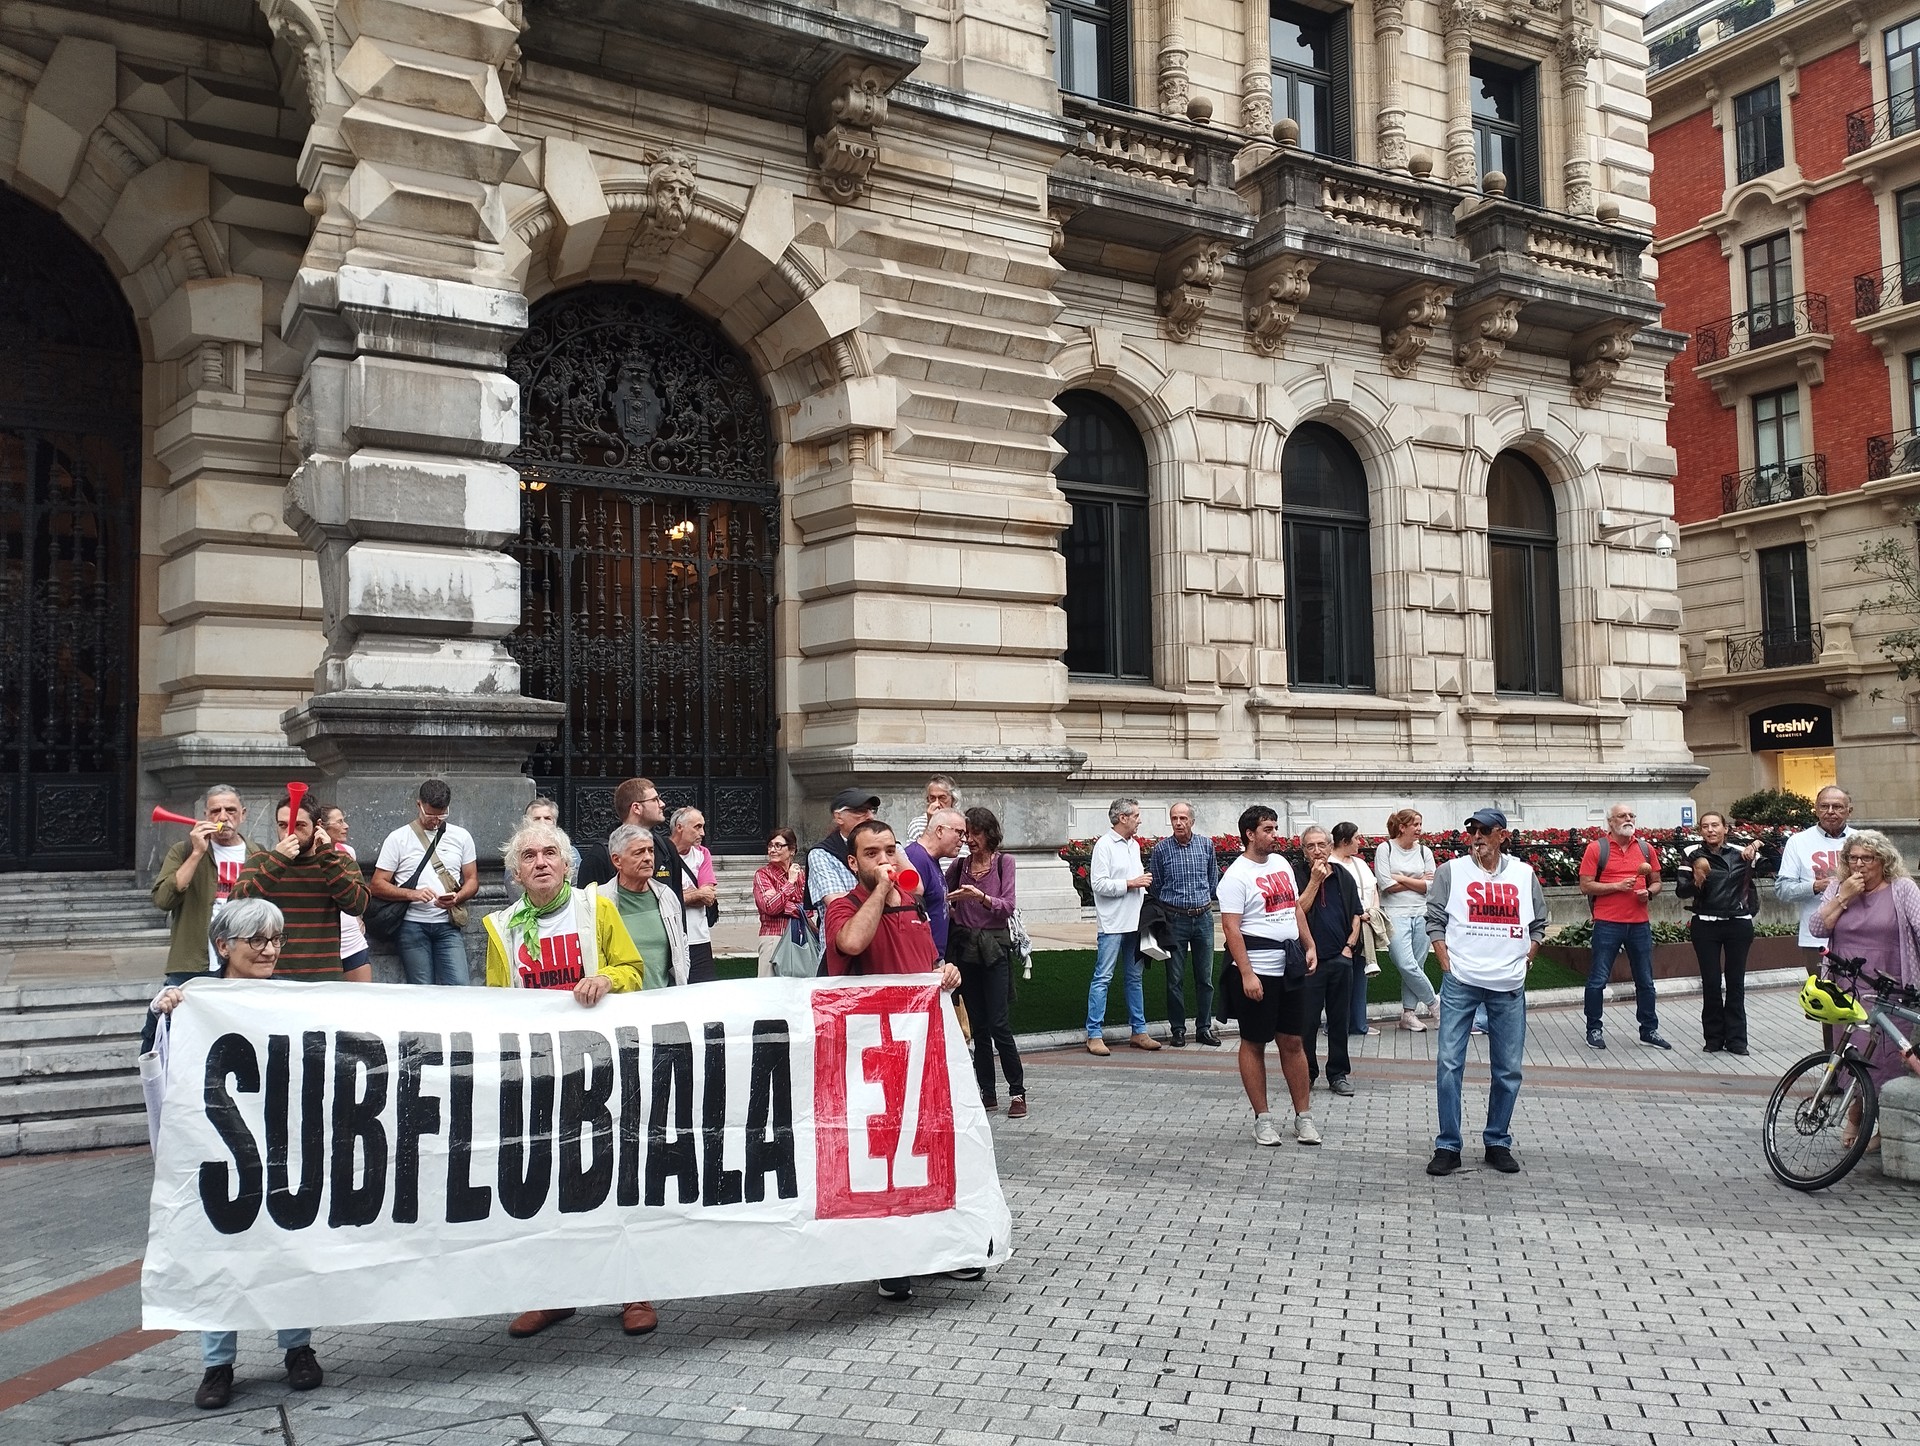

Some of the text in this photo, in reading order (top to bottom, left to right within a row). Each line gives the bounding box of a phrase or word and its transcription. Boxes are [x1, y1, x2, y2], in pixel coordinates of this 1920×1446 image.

[1763, 718, 1815, 734] Freshly
[1256, 870, 1295, 898] SUB
[1466, 881, 1520, 907] SUB
[1469, 904, 1519, 918] FLUBIALA
[199, 1012, 931, 1235] SUBFLUBIALA EZ
